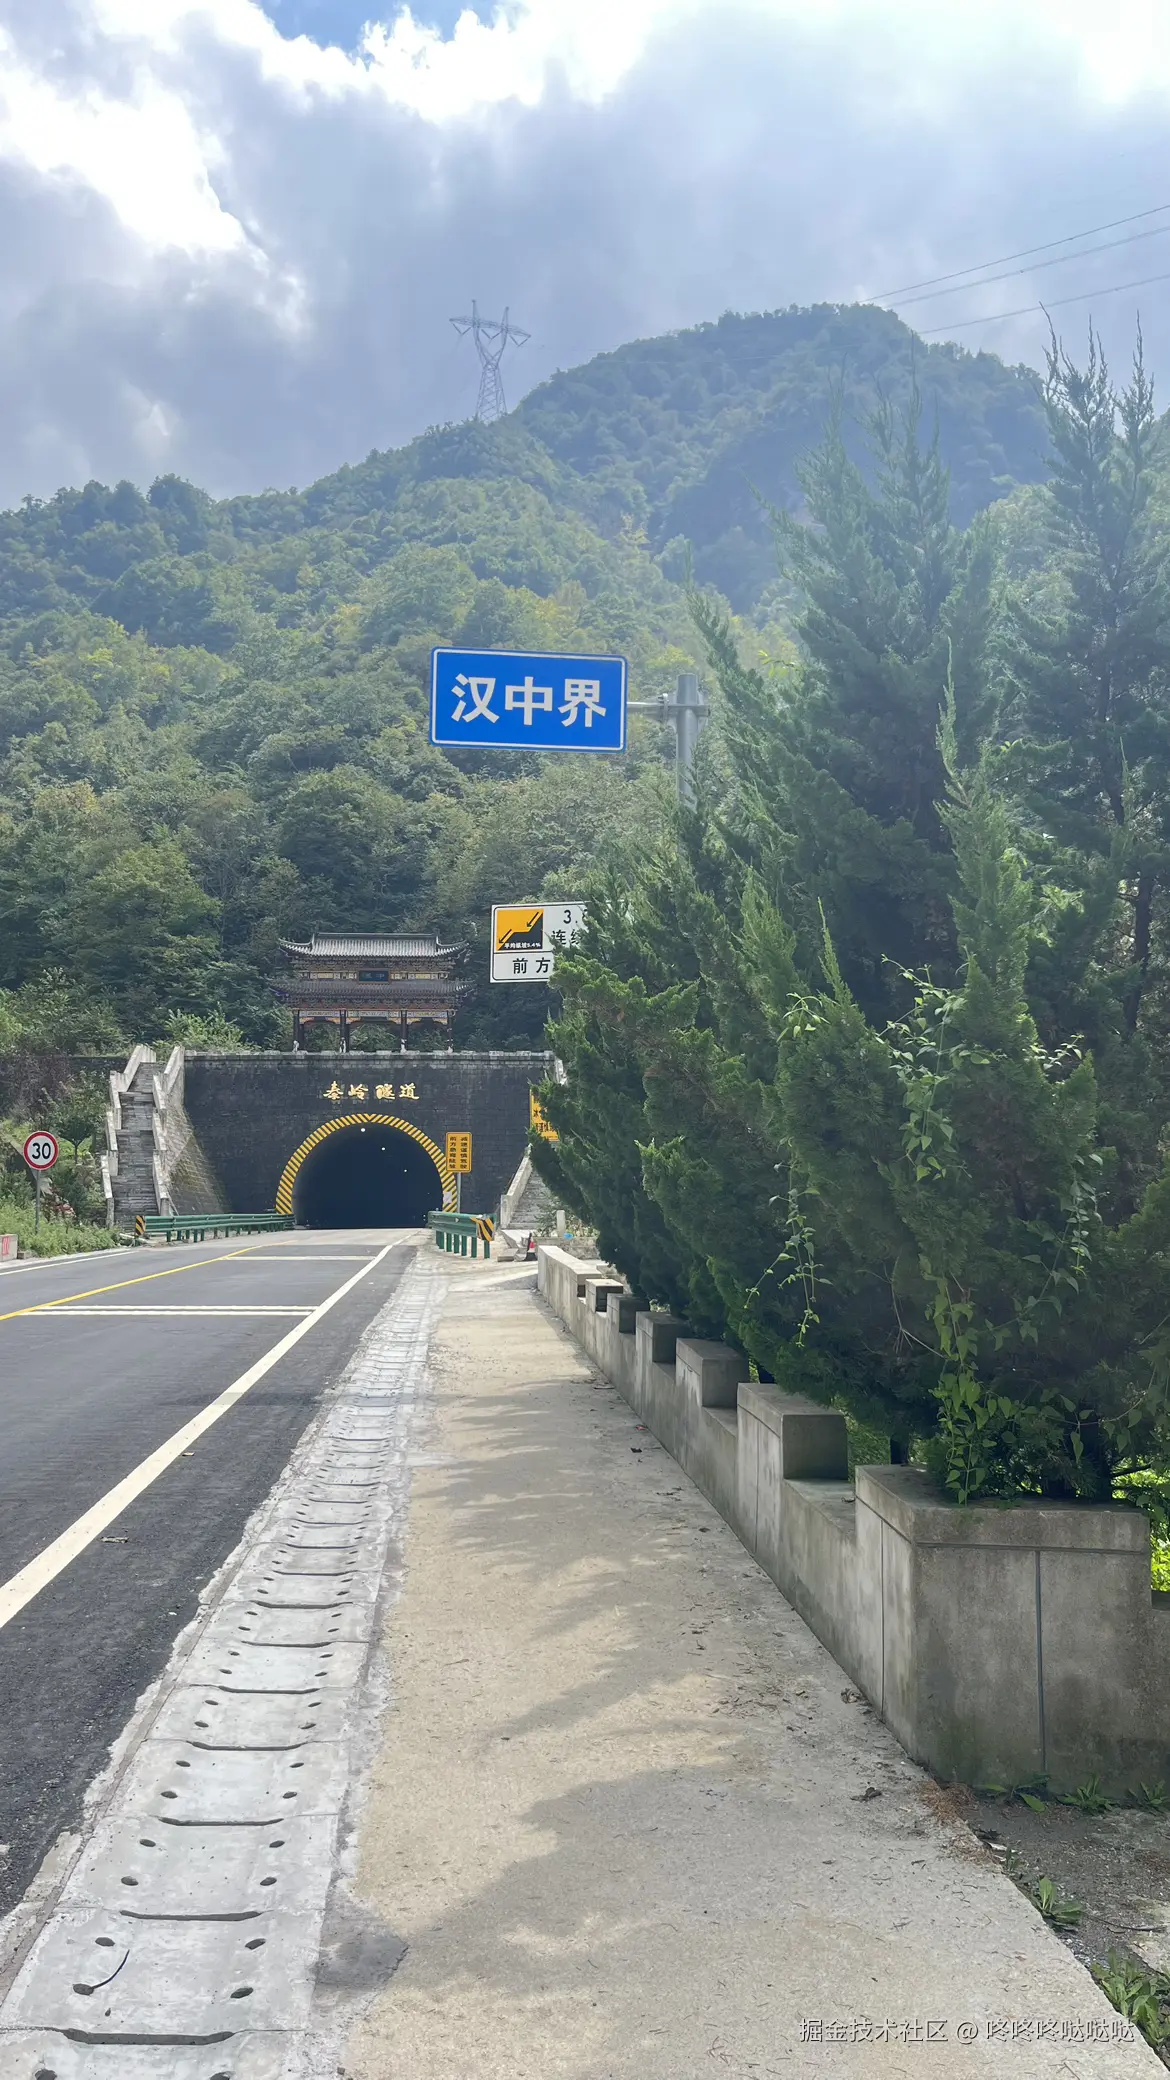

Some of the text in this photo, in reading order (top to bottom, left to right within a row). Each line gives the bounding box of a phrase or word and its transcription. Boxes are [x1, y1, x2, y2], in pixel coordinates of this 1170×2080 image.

[451, 673, 606, 728] 汉中界
[512, 957, 551, 974] 前方
[323, 1081, 419, 1100] 秦岭隧道
[31, 1142, 52, 1160] 30
